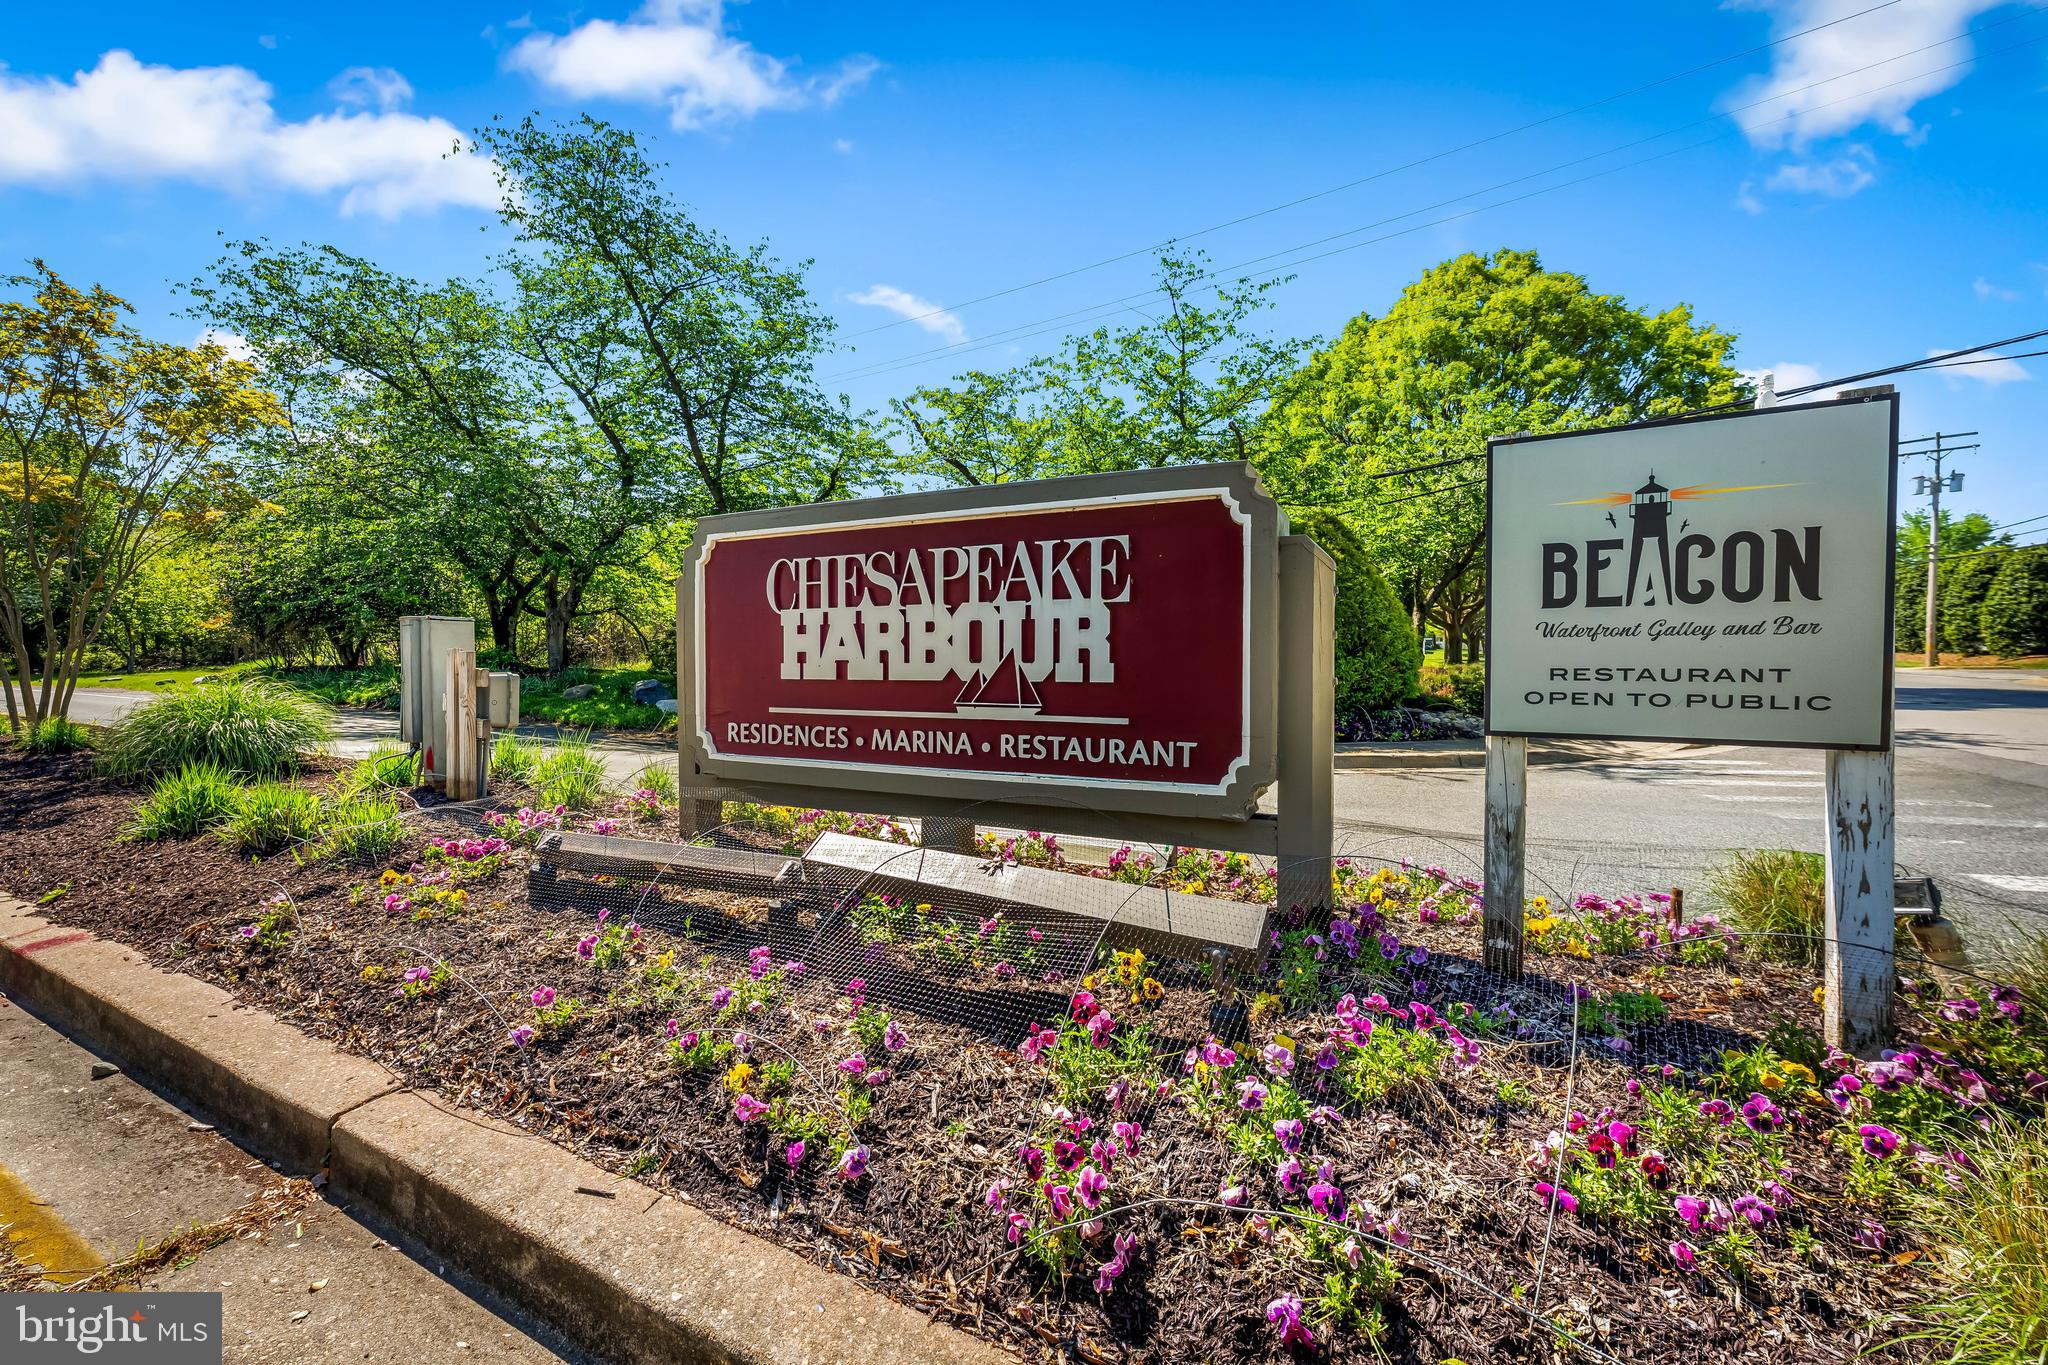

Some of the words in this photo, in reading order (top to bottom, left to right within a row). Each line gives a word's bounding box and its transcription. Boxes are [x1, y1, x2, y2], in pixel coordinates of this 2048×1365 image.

[766, 534, 1132, 615] CHESAPEAKE
[1541, 525, 1823, 610] BEACON
[780, 600, 1115, 684] HARBOUR
[1535, 620, 1641, 642] Waterfront
[1647, 618, 1716, 642] Galley
[1722, 619, 1765, 636] and
[1772, 615, 1823, 636] Bar
[1549, 667, 1792, 683] RESTAURANT
[1523, 690, 1613, 706] OPEN
[1627, 692, 1672, 708] TO
[1685, 693, 1832, 711] PUBLIC
[727, 721, 849, 749] RESIDENCES
[871, 728, 974, 756] MARINA
[1000, 733, 1198, 768] RESTAURANT
